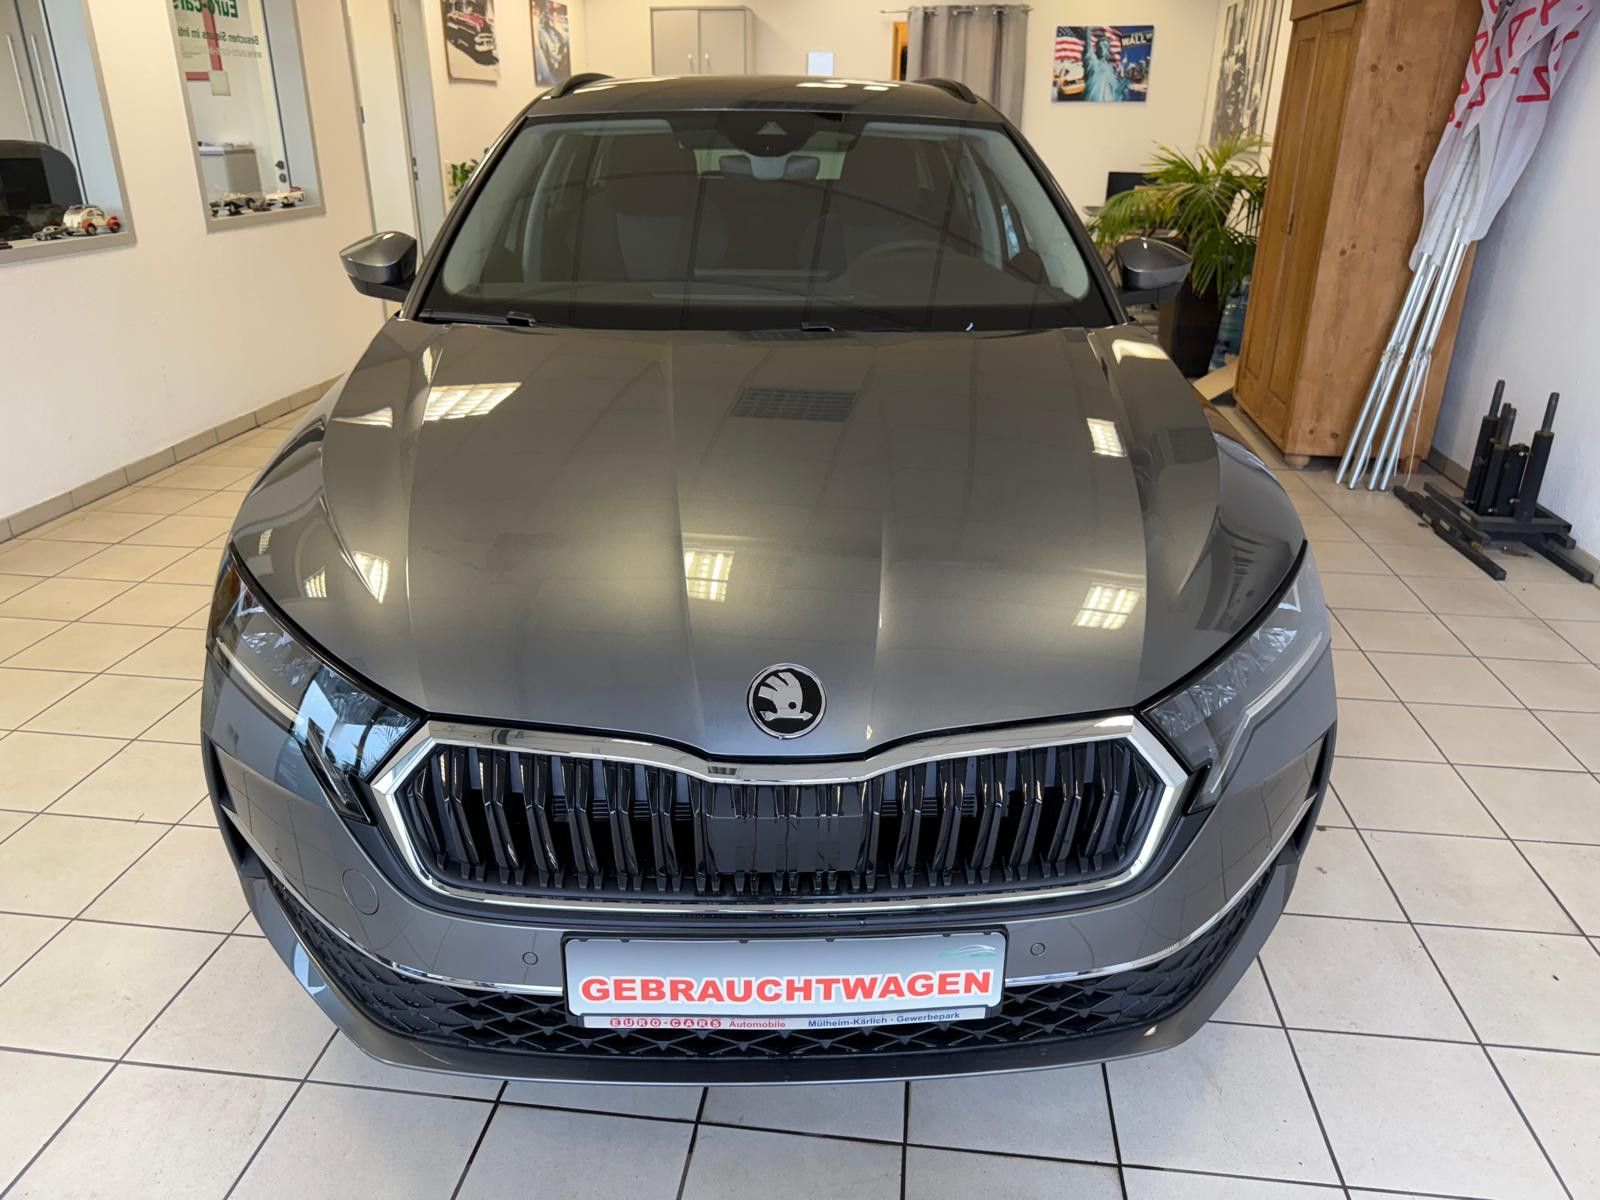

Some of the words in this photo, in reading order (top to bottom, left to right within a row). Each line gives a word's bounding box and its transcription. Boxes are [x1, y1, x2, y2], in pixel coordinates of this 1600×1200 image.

[581, 971, 992, 1003] GEBRAUCHTWAGEN
[609, 1016, 722, 1029] EURO-CARS
[728, 1019, 786, 1029] Automobile
[808, 1016, 888, 1028] Mülheim-Kärlich
[896, 1010, 961, 1024] Gewerbepark
